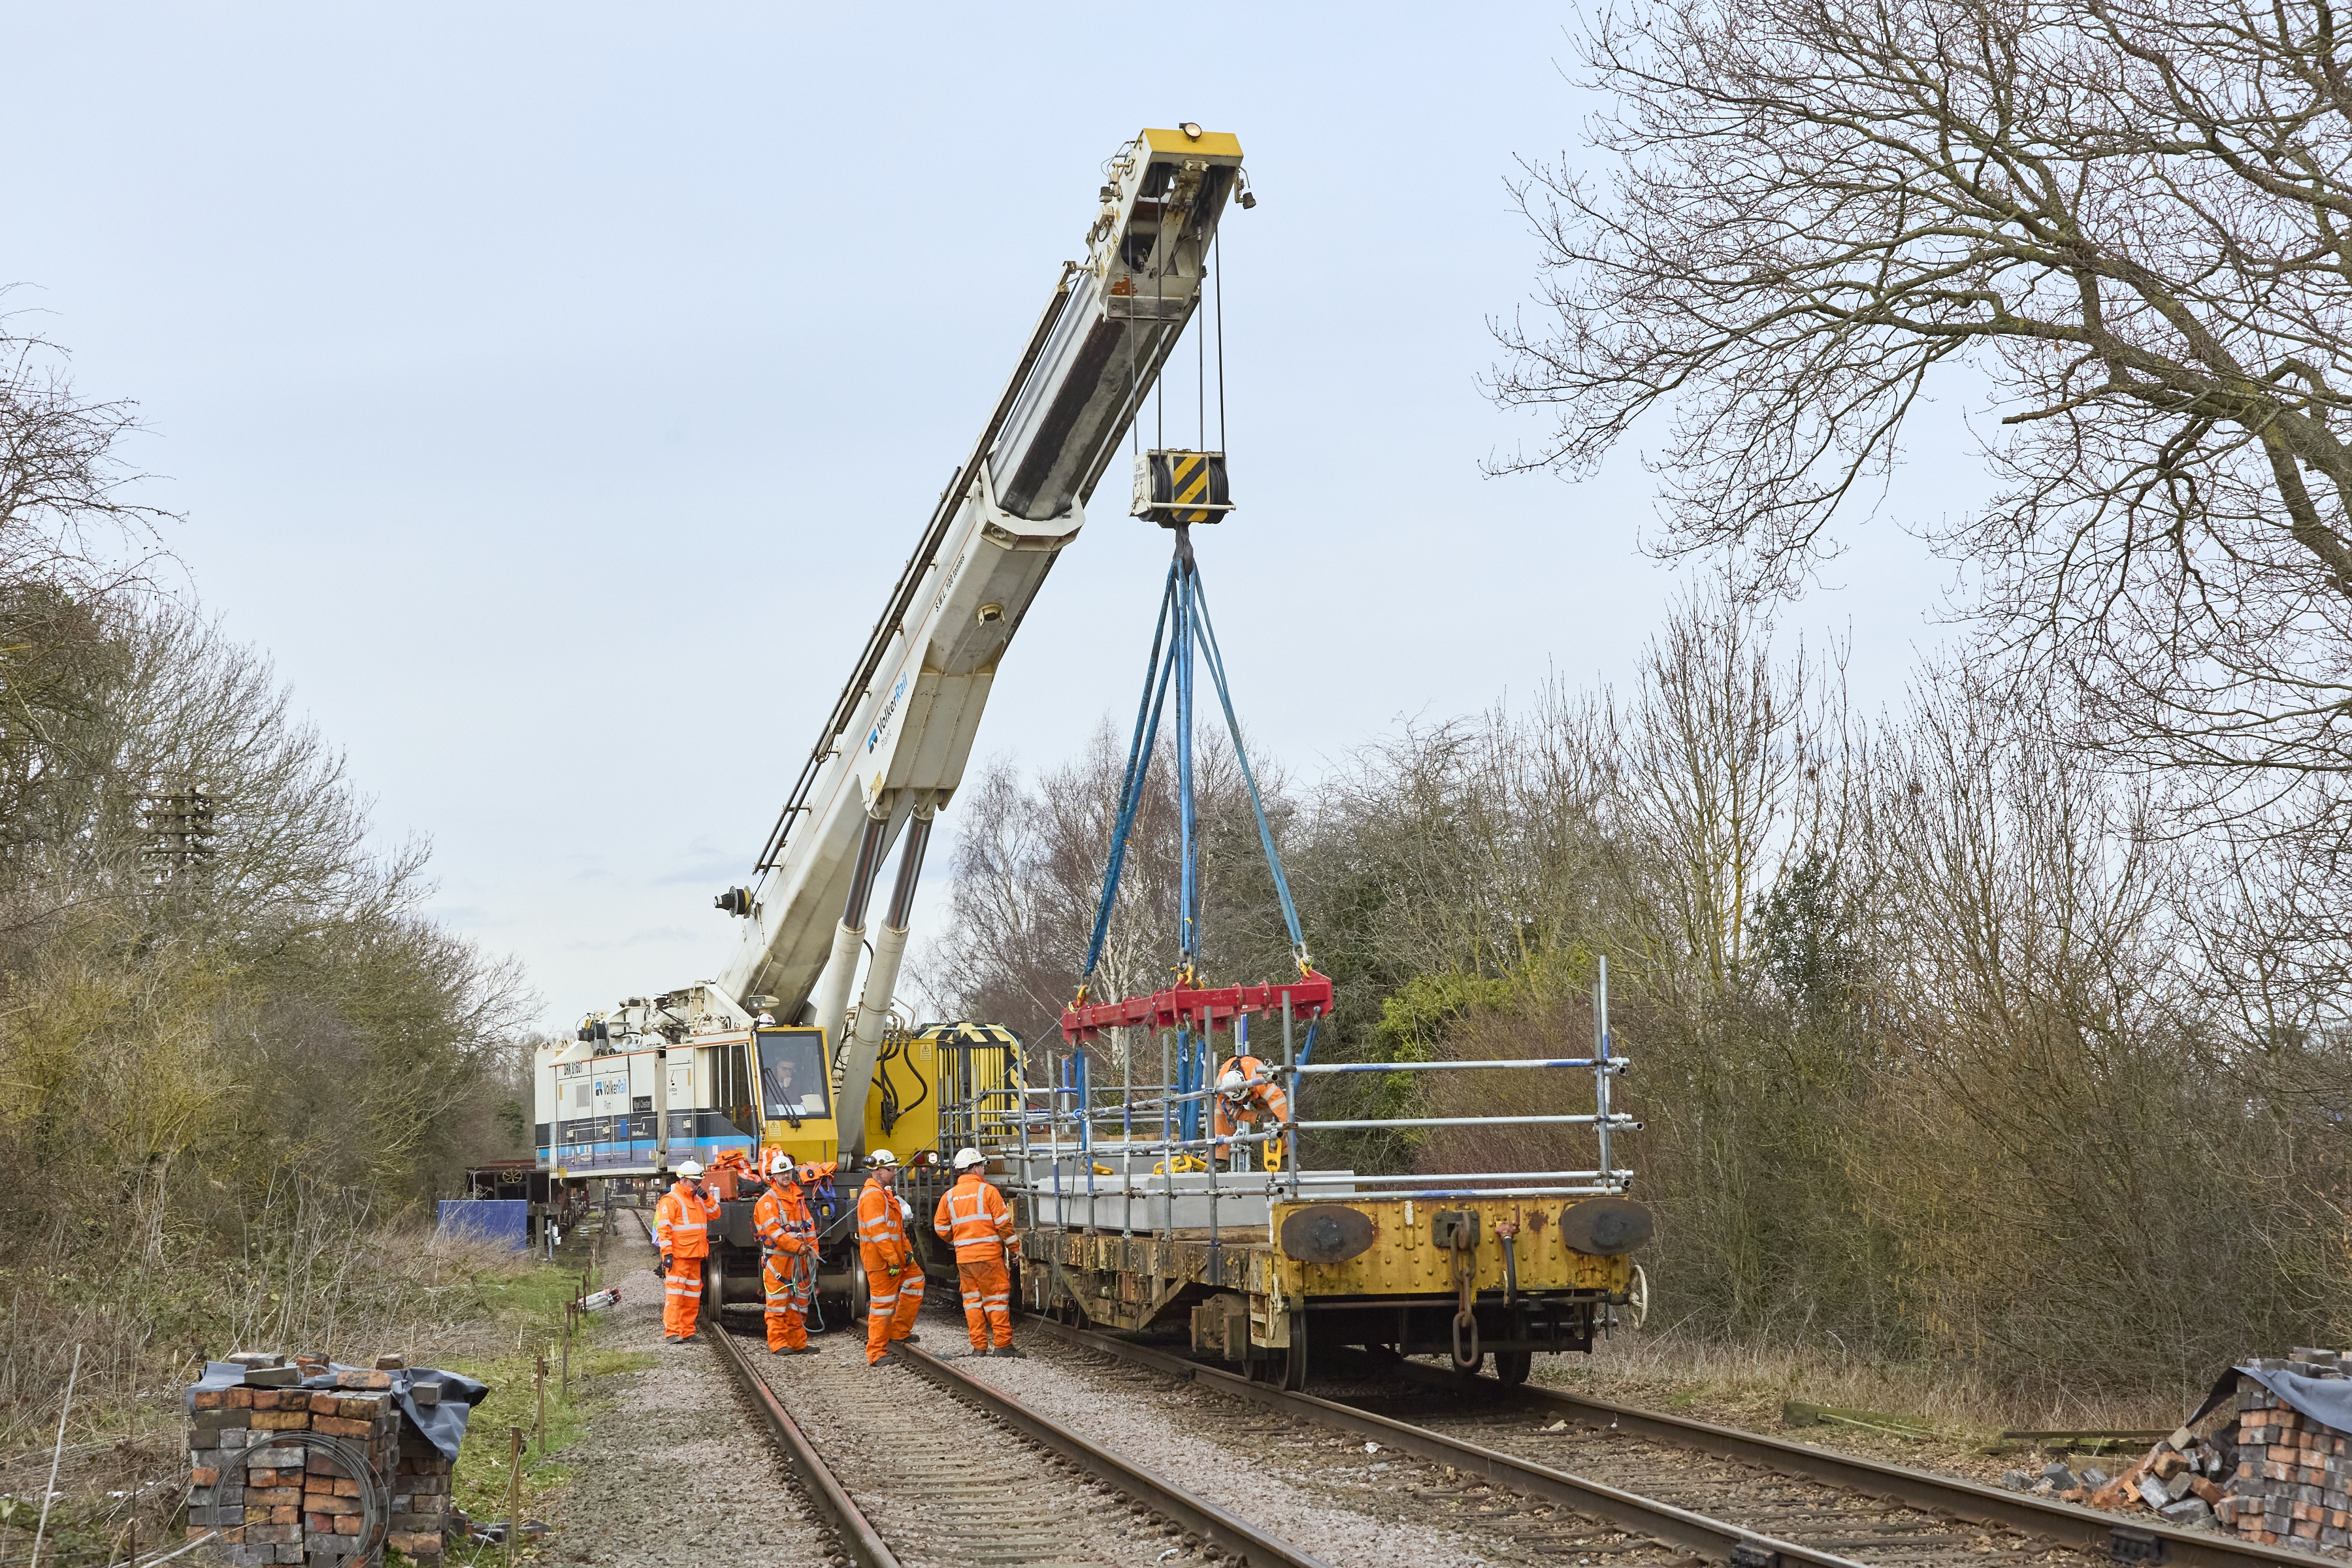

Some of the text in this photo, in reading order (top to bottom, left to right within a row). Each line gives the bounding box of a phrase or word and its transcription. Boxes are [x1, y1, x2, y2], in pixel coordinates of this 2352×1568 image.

[936, 590, 947, 612] S.W.L.
[953, 553, 965, 578] tonnes
[877, 671, 907, 734] VolkerRail
[881, 729, 892, 751] Plant
[572, 1060, 583, 1075] 81601
[602, 1078, 627, 1095] VolkerRail
